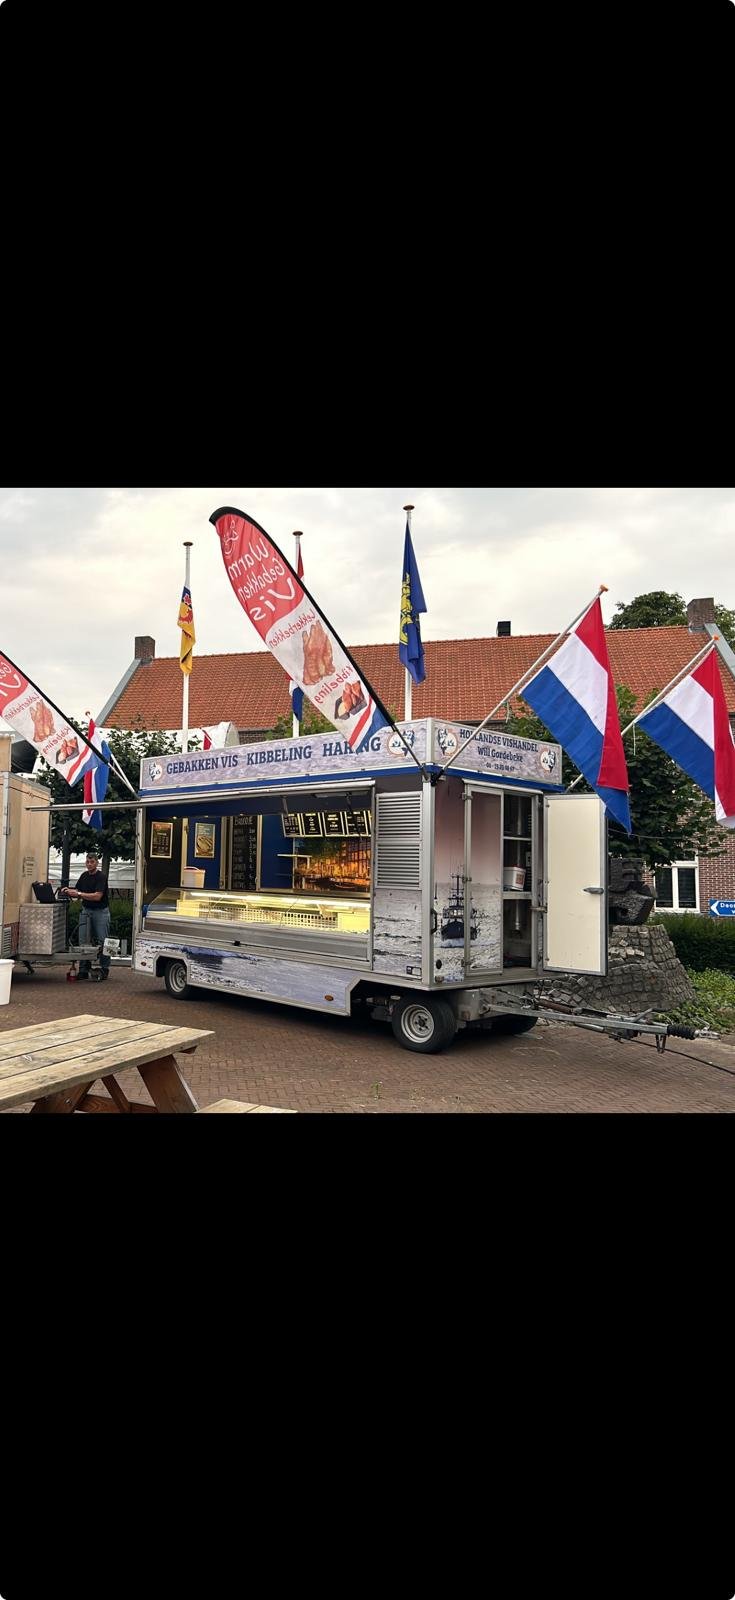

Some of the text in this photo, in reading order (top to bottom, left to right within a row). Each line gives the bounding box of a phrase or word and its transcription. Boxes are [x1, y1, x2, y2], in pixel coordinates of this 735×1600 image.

[477, 746, 491, 757] Will
[502, 737, 539, 752] VISHANDEL
[166, 737, 381, 775] GEBAKKEN VIS KIBBELING HARNG
